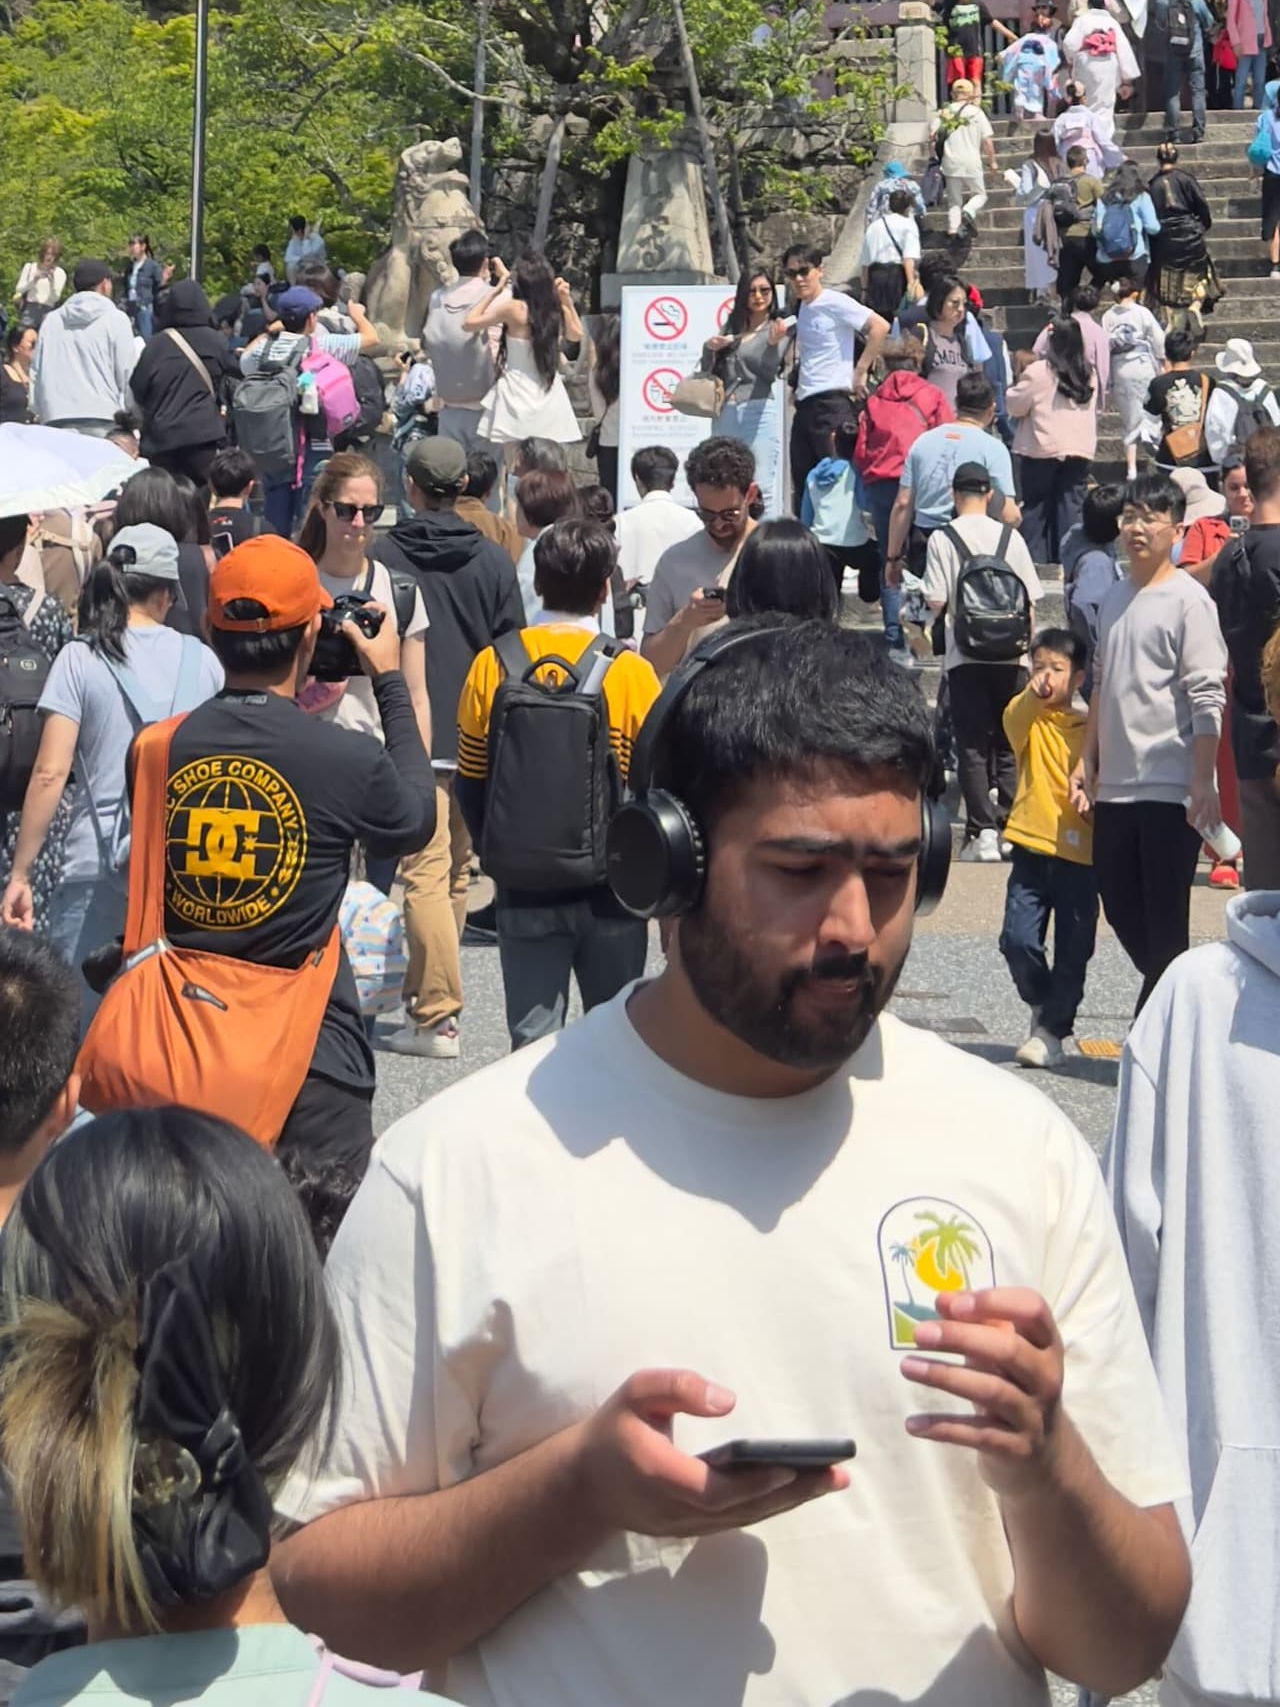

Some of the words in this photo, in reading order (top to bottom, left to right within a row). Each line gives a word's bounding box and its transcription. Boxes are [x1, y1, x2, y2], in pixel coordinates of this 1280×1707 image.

[173, 760, 223, 794] SHOE
[228, 761, 300, 831] COMPANY
[186, 807, 261, 879] DC
[171, 894, 272, 924] WORLDWIDE
